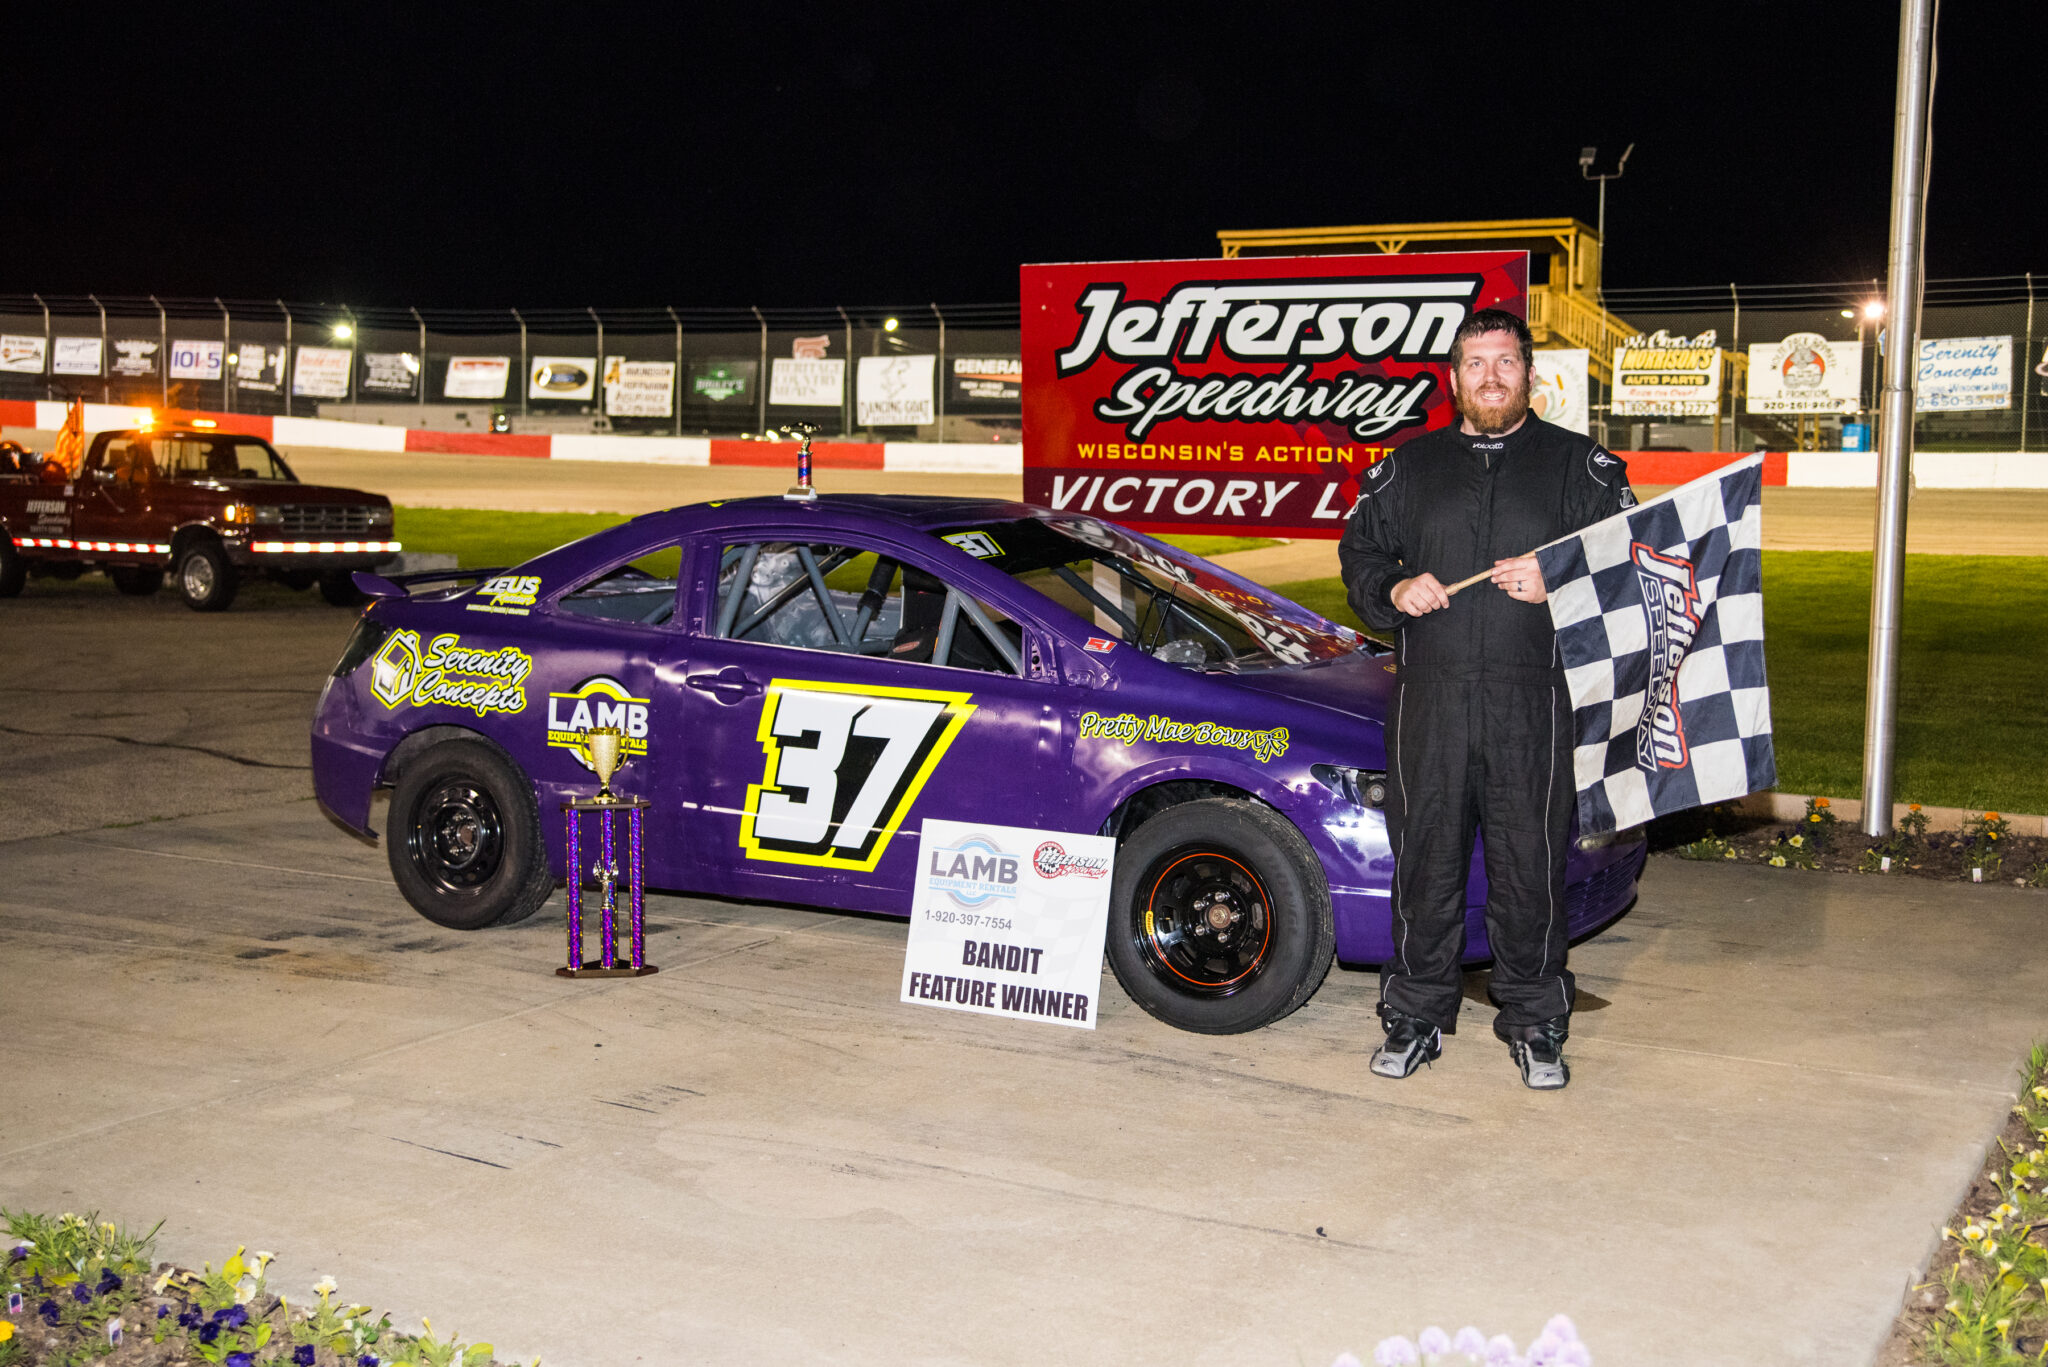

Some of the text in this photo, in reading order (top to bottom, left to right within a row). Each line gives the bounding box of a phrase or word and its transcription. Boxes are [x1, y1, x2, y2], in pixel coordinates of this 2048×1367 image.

[1060, 281, 1476, 371] Jefferson
[1620, 347, 1716, 370] MORRISON'S
[1918, 341, 2002, 361] Serenity
[1625, 375, 1705, 385] AUTO PARTS
[1918, 363, 1999, 381] Concepts
[1099, 364, 1430, 437] Speedway
[1077, 441, 1244, 462] WISCONSIN'S
[1255, 446, 1355, 464] ACTION
[1048, 474, 1300, 517] VICTORY
[945, 533, 1001, 558] 37
[478, 576, 541, 595] ZEUS
[422, 635, 530, 688] Serenity
[1636, 548, 1697, 764] Jefferson
[1640, 579, 1665, 766] SPEEDWAY
[412, 669, 524, 715] Concepts
[547, 697, 649, 739] LAMB
[1081, 712, 1251, 748] Pretty Mae Bows
[750, 686, 955, 858] 37
[929, 850, 1019, 885] LAMB
[1033, 852, 1109, 869] JEFFERSON
[928, 877, 1017, 895] EQUIPMENT RENTALS
[925, 909, 1013, 931] 1-920-397-7554
[962, 939, 1044, 975] BANDIT
[909, 971, 1089, 1022] FEATURE WINNER
